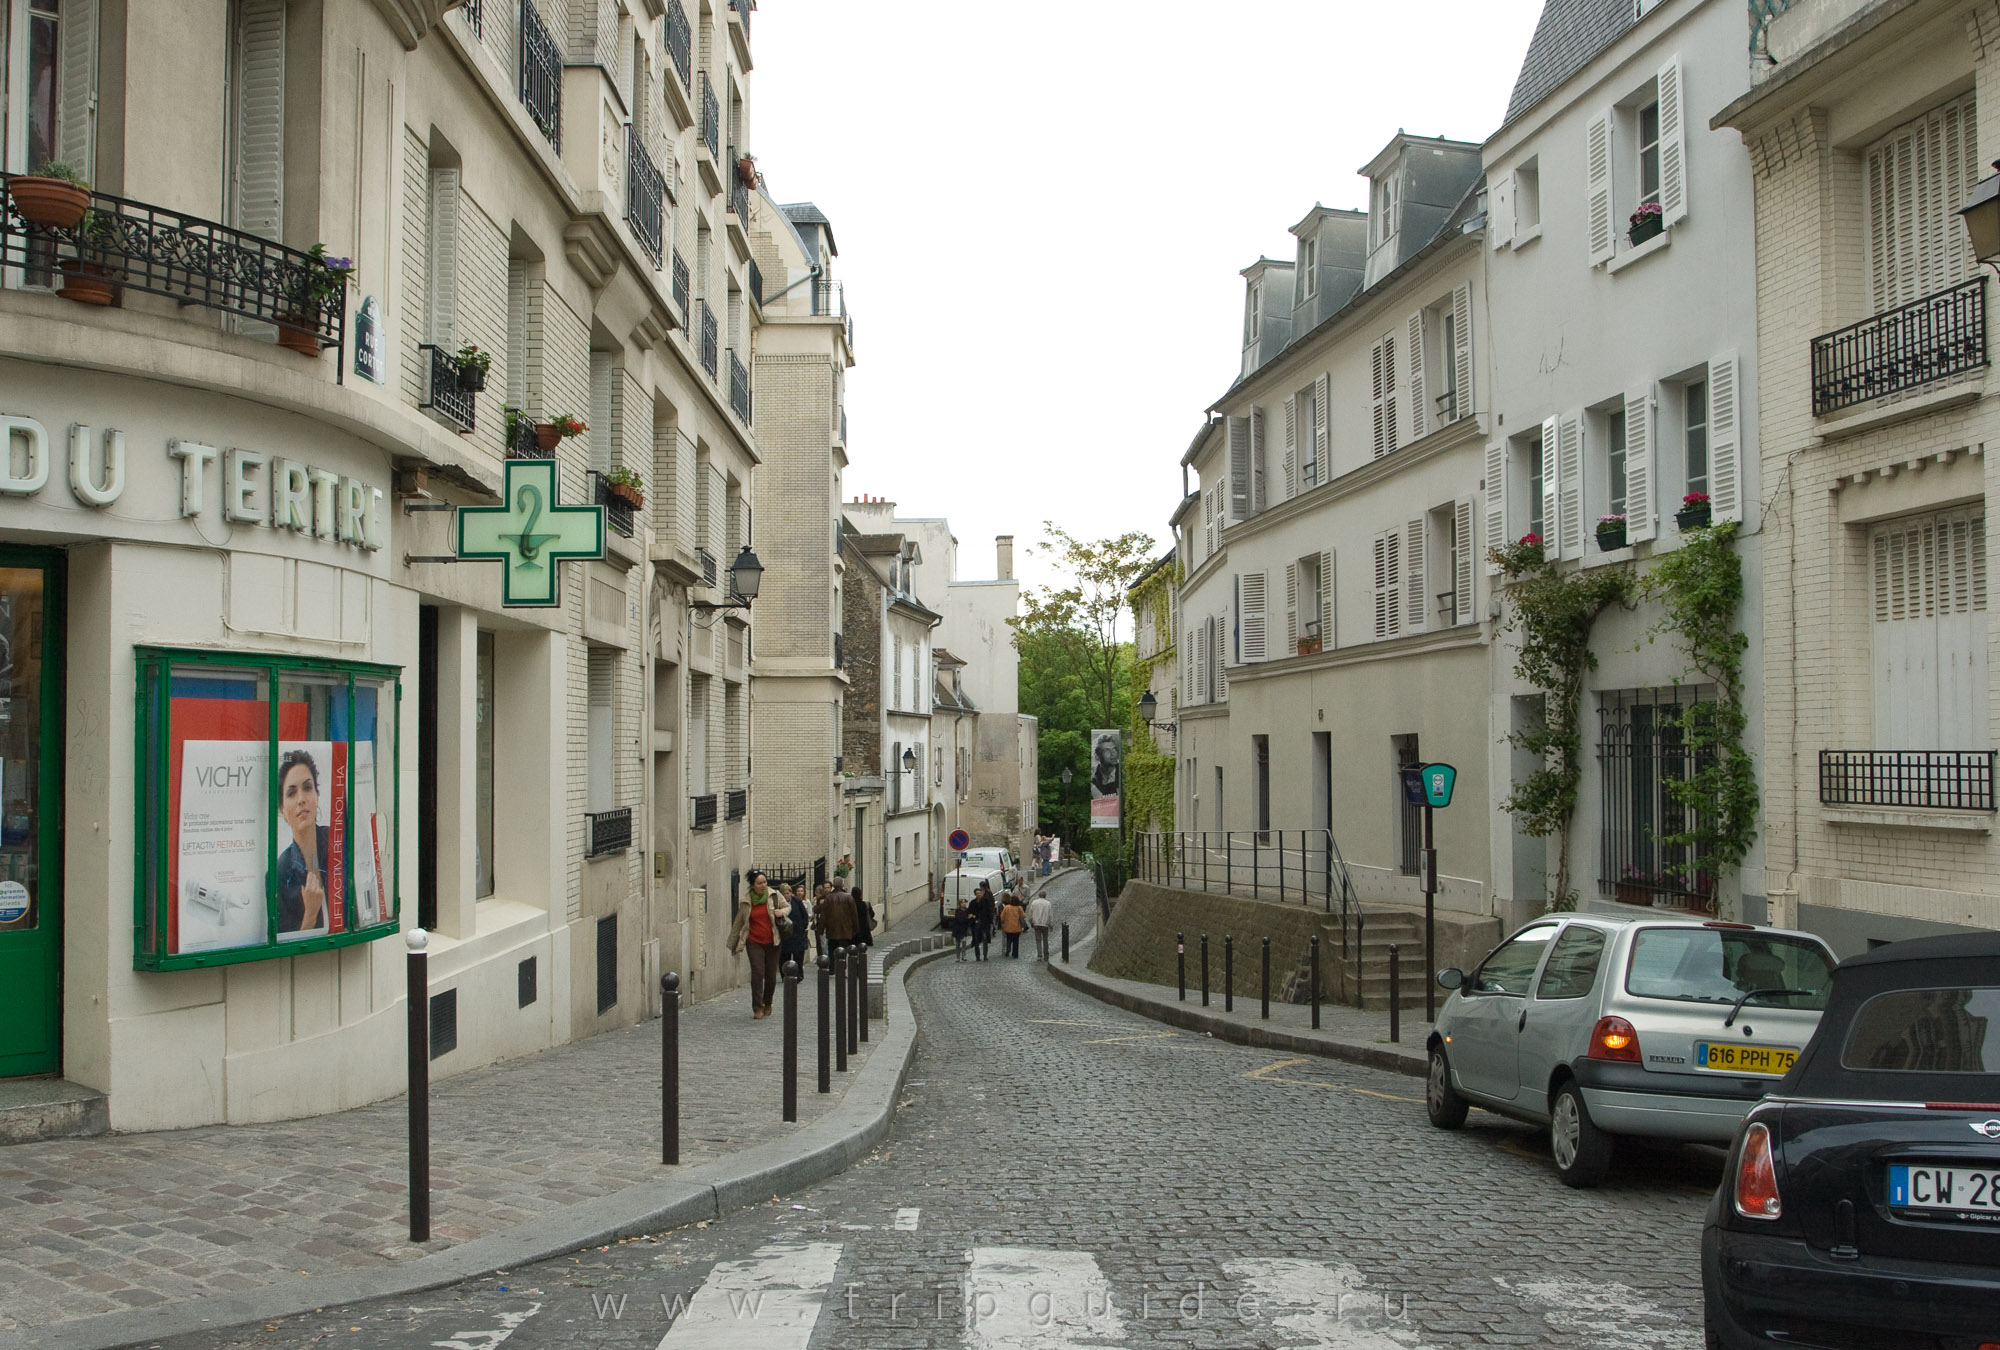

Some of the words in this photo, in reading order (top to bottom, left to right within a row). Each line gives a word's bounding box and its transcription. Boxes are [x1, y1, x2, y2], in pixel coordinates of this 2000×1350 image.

[365, 331, 378, 352] RUE
[0, 413, 126, 508] DU
[168, 437, 384, 553] TERTRE
[195, 766, 253, 788] VICHY
[182, 841, 216, 851] LIFTACTIV
[216, 839, 245, 848] RETINOL
[1649, 1054, 1685, 1064] RENAULT
[1709, 1047, 1735, 1064] 616
[1740, 1050, 1770, 1067] PPH
[1776, 1052, 1795, 1069] 75
[1912, 1170, 1953, 1204] CW
